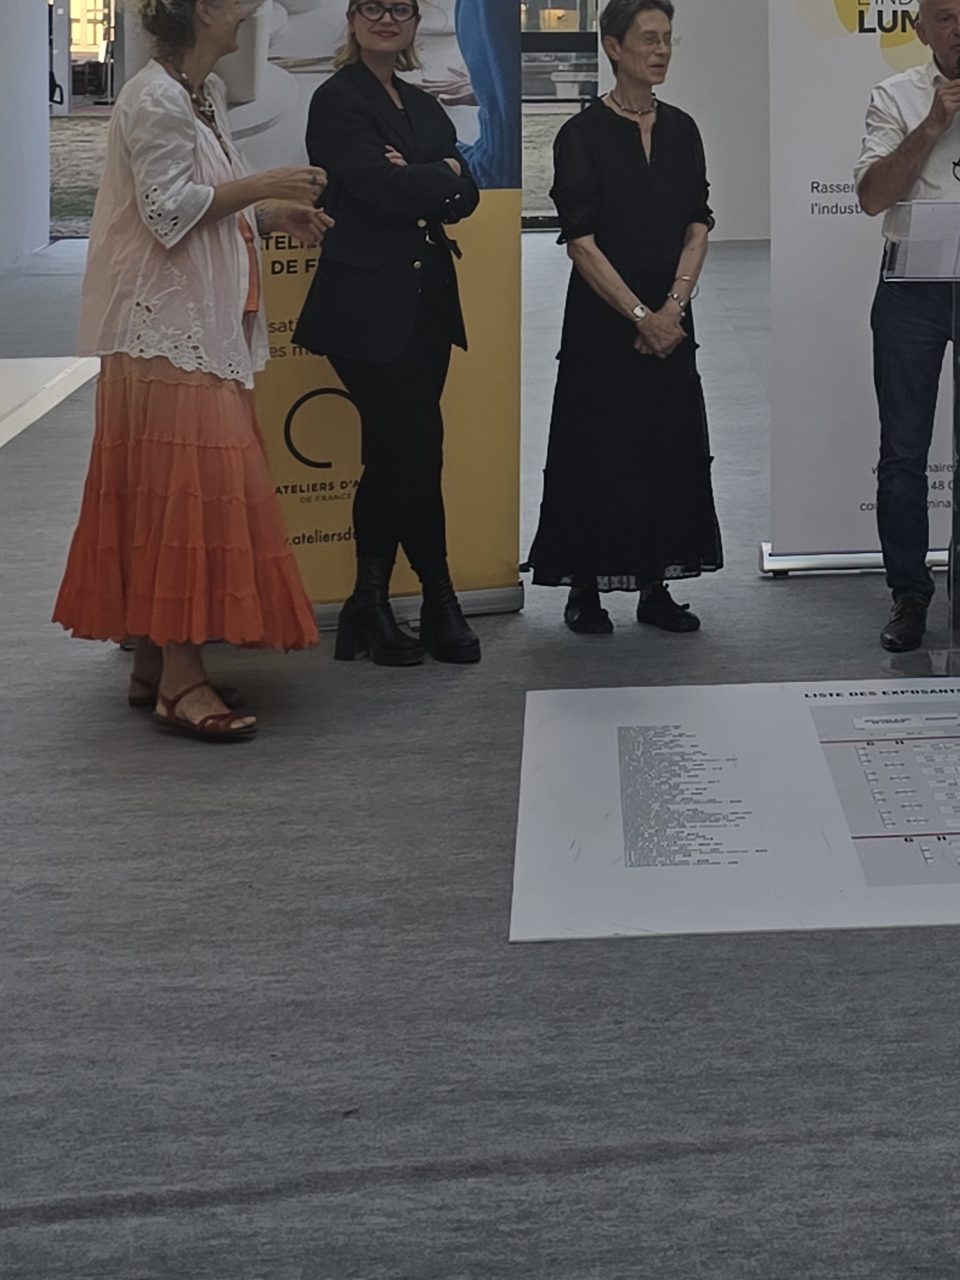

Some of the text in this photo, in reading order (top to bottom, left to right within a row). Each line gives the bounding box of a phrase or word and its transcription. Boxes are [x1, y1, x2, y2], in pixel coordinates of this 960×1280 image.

[811, 202, 863, 215] l'indust
[271, 260, 298, 275] DE
[274, 481, 335, 495] ATELIERS
[315, 493, 352, 502] FRANCE
